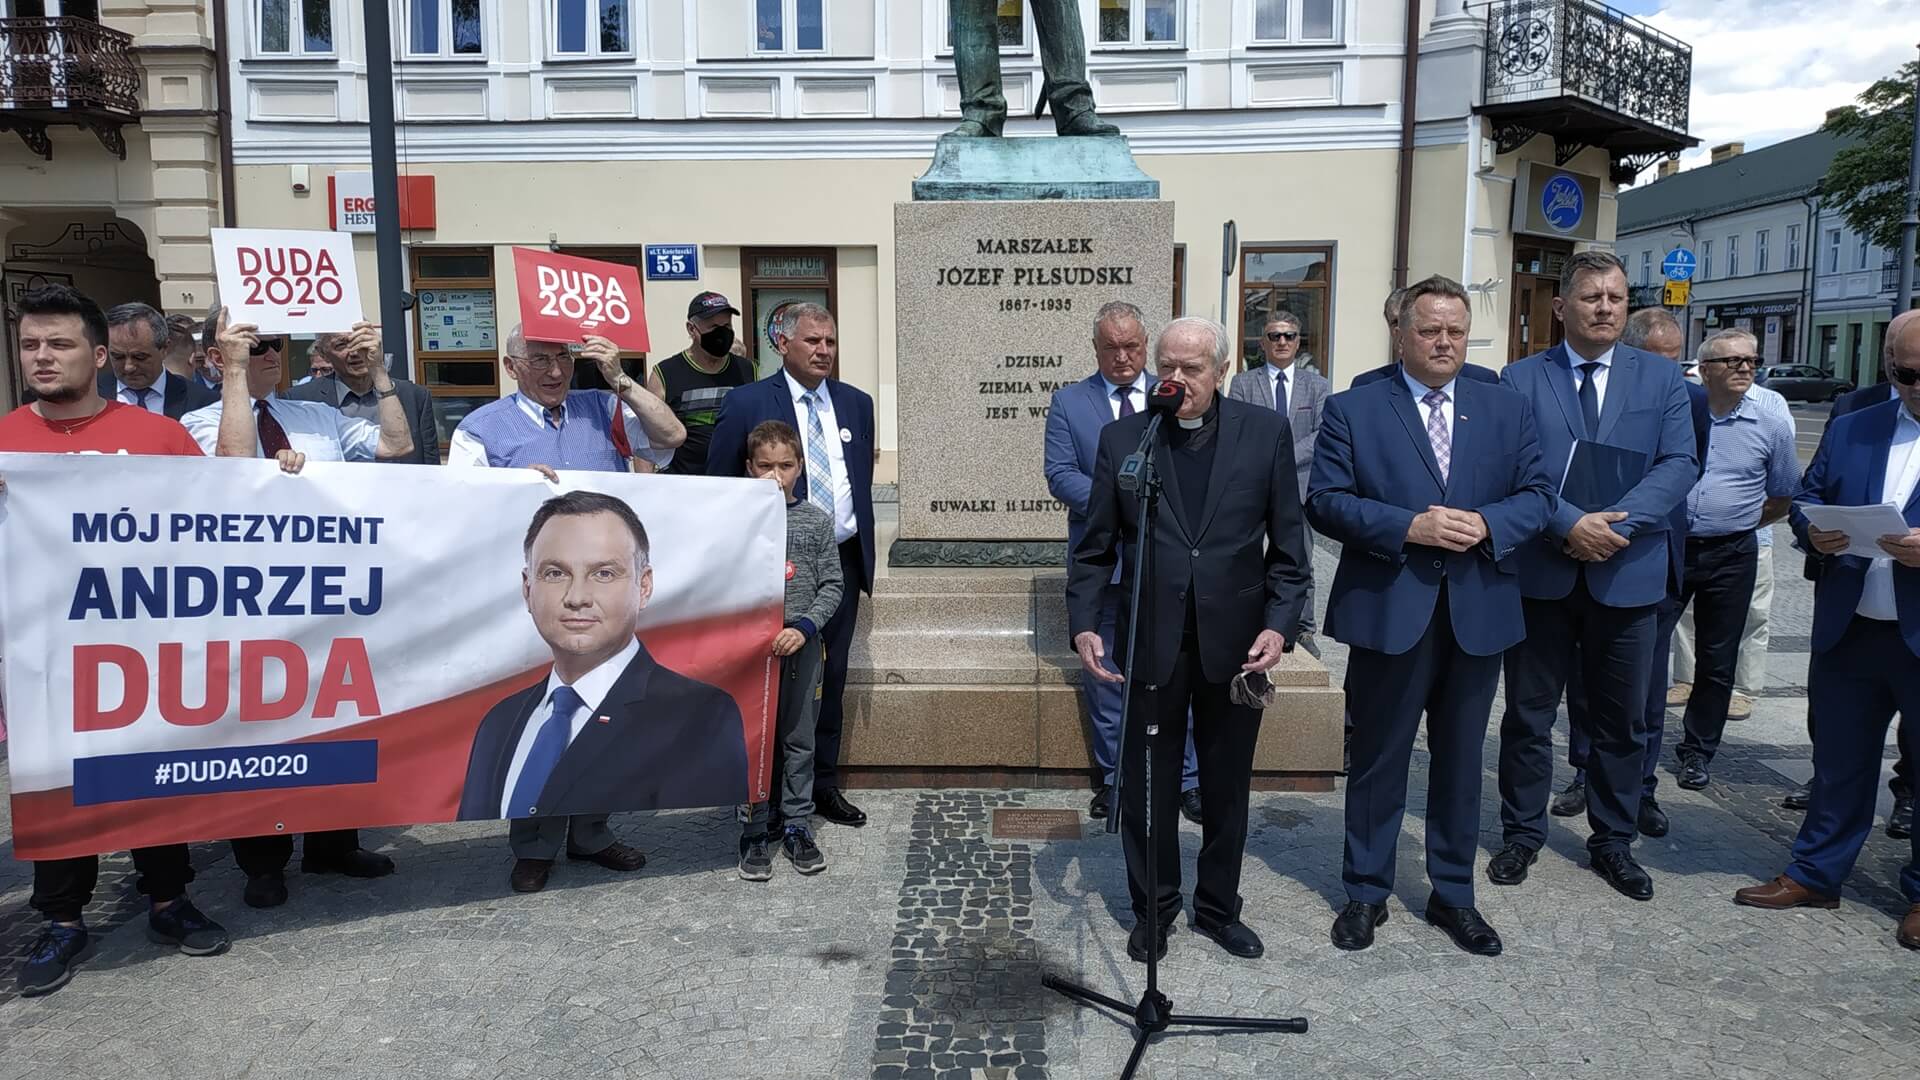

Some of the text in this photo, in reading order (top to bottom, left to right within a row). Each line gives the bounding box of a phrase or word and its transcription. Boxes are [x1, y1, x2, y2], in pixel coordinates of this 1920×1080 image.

[344, 213, 376, 225] HEST
[976, 238, 1094, 254] MARSZAŁEK
[236, 247, 339, 277] DUDA
[656, 254, 686, 273] 55
[936, 266, 1134, 286] JÓZEF PIŁSUDSKI
[243, 276, 343, 306] 2020
[537, 264, 628, 303] DUDA
[538, 289, 631, 326] 2020
[979, 381, 1079, 394] ZIEMIA WA
[984, 406, 1019, 420] JEST
[930, 500, 997, 513] SUWAŁKI
[72, 507, 385, 545] MÓJ PREZYDENT
[67, 565, 384, 620] ANDRZEJ
[73, 637, 382, 733] DUDA
[154, 754, 309, 785] #DUDA2020
